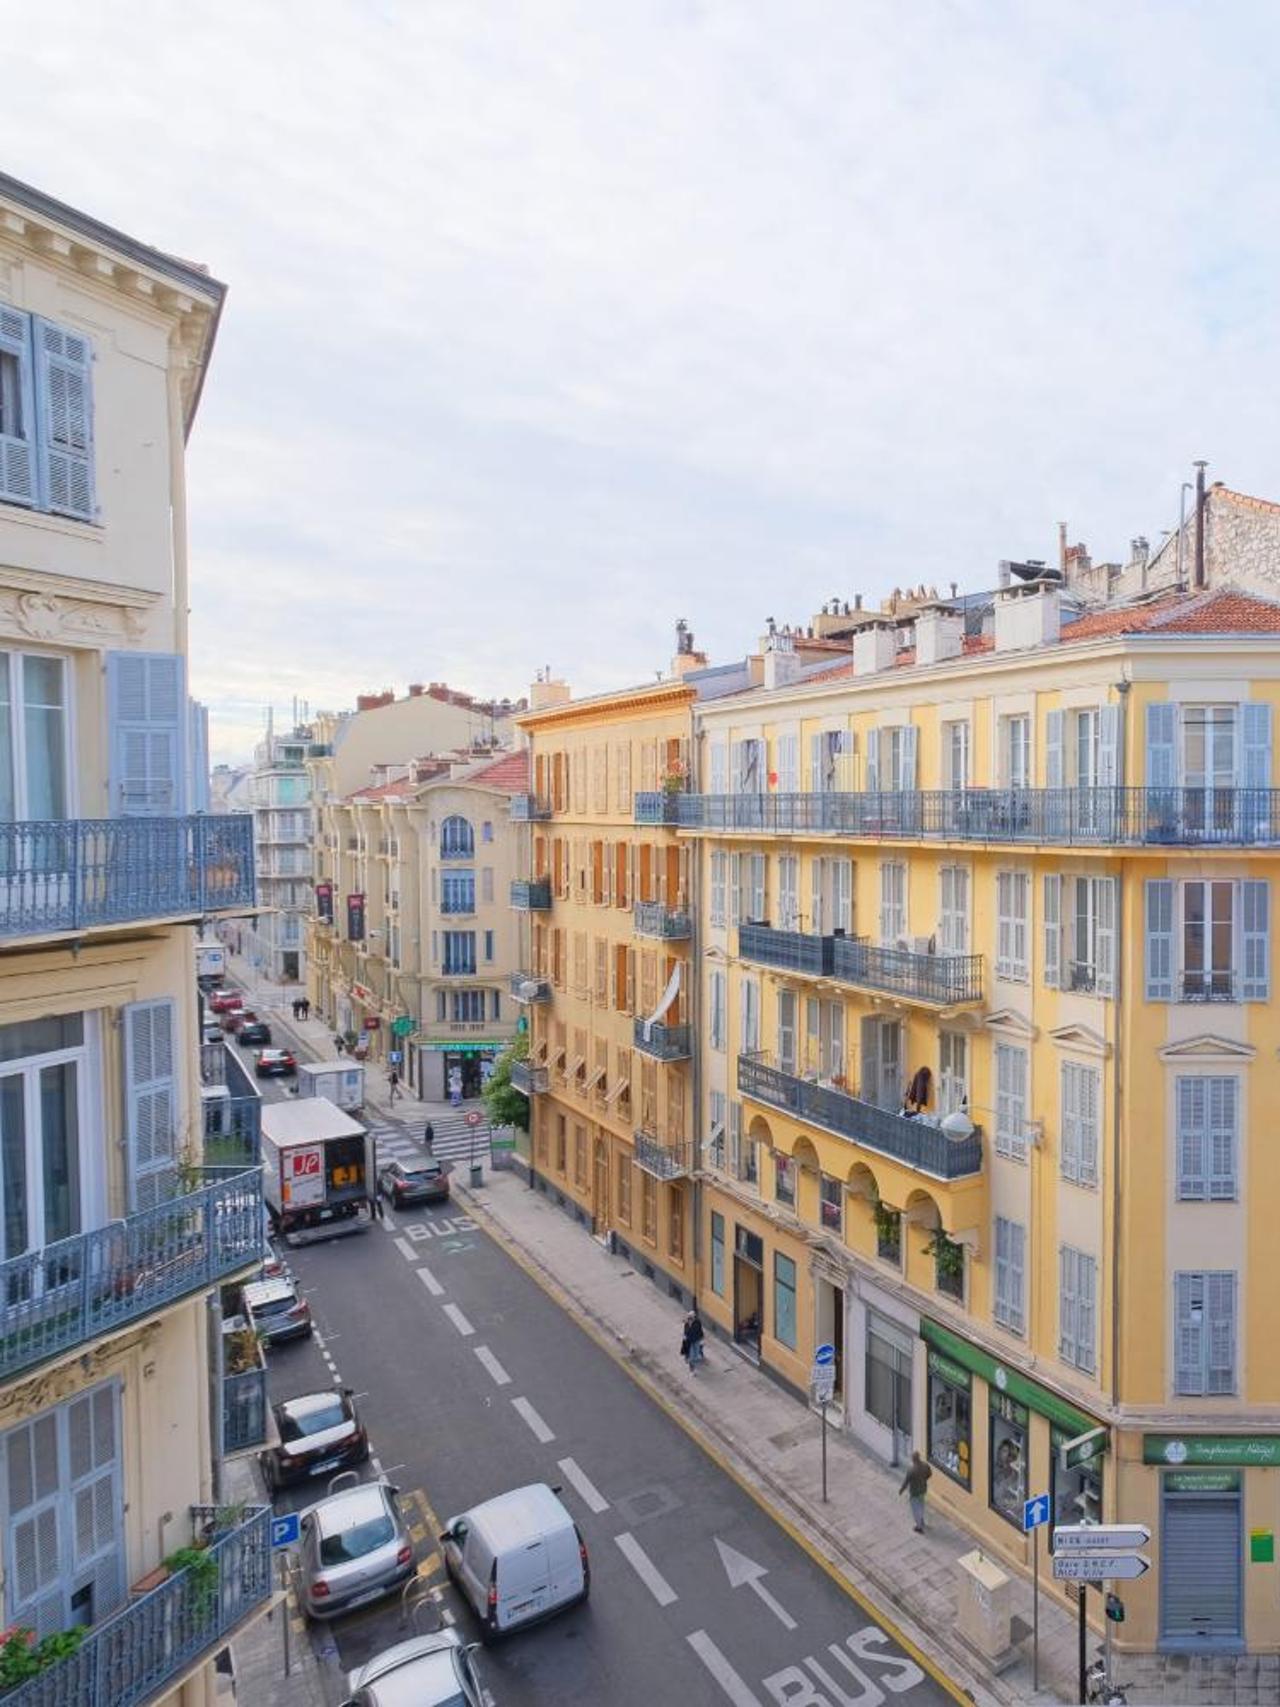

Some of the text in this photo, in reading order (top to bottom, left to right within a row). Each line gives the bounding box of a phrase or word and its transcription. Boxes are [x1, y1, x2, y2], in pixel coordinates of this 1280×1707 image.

[402, 1216, 480, 1241] BUS
[274, 1522, 291, 1542] P
[762, 1626, 926, 1707] BUS
